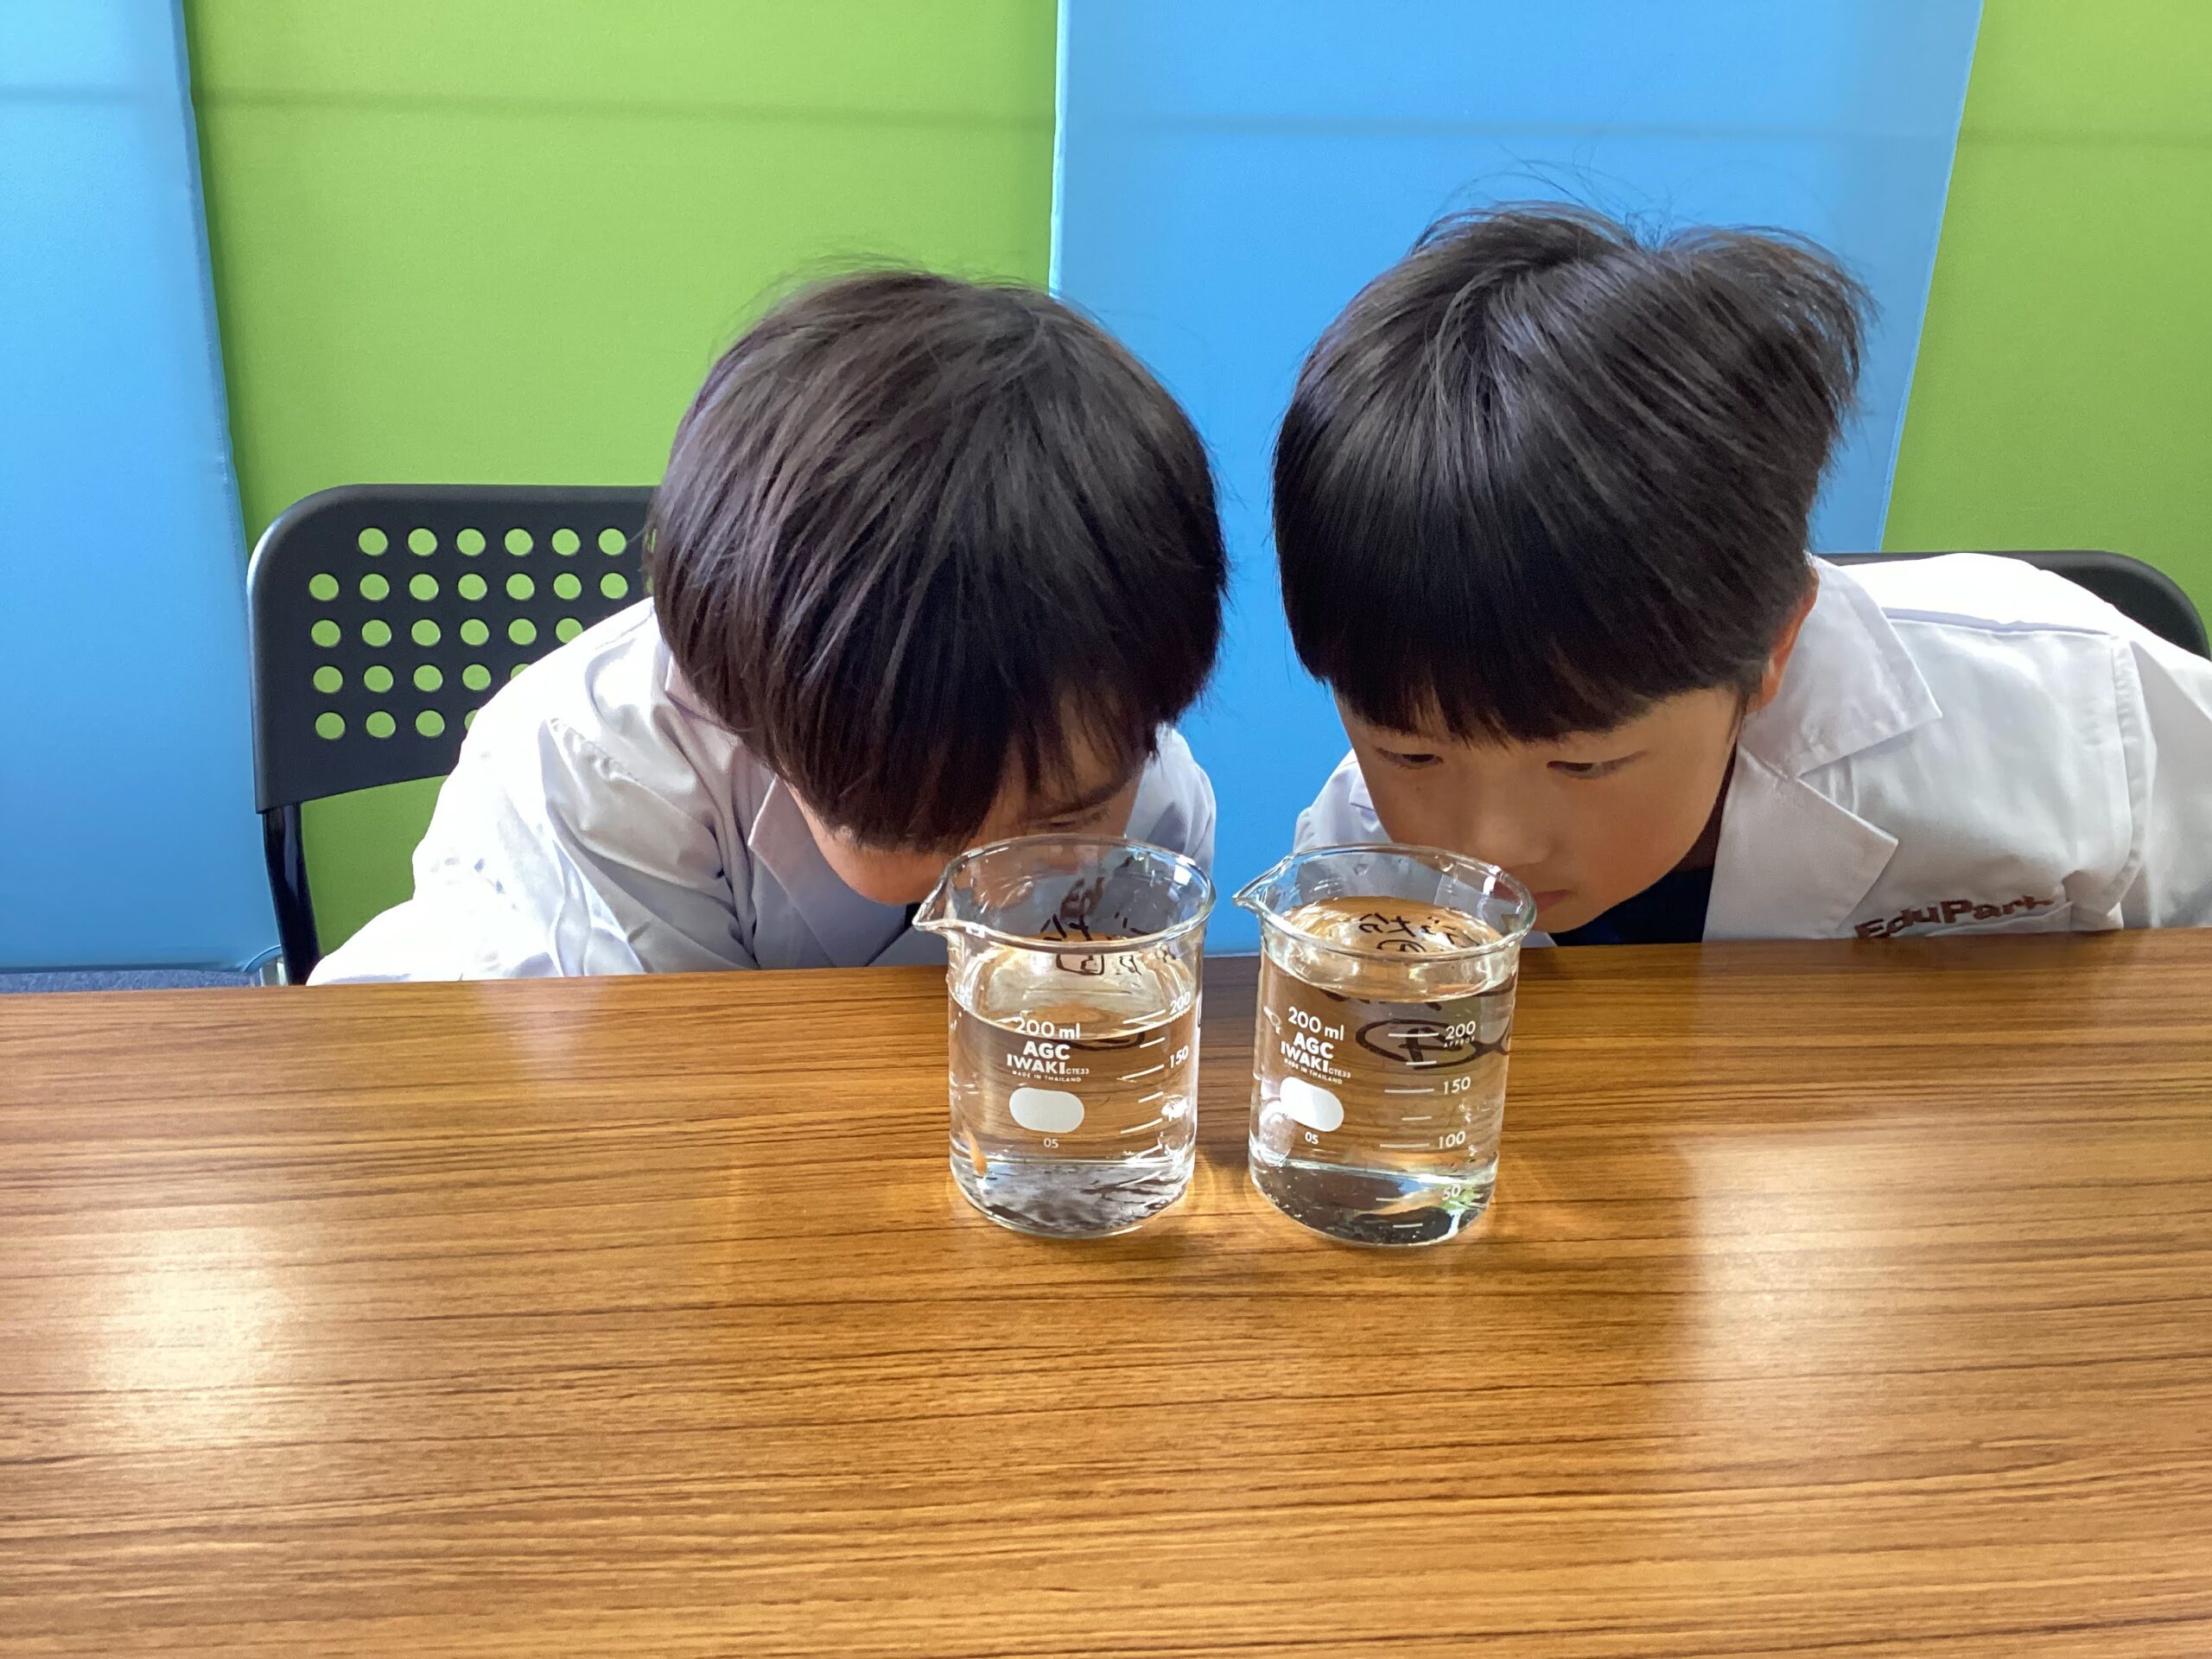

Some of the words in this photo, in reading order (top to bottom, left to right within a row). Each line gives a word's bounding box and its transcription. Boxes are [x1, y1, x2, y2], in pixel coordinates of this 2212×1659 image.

[1014, 1018, 1055, 1038] 200
[1059, 1022, 1080, 1039] ml
[1287, 1006, 1322, 1033] 200
[1324, 1024, 1344, 1041] ml
[1445, 1020, 1476, 1040] 200
[1023, 1040, 1071, 1060] AGC
[1293, 1032, 1334, 1058] AGC
[1007, 1053, 1065, 1074] IWAKI
[1169, 1045, 1189, 1069] 150
[1281, 1040, 1329, 1073] IWAKI
[1309, 1070, 1343, 1084] THAILAND
[1442, 1076, 1471, 1096] 150
[1044, 1138, 1059, 1148] 05
[1305, 1131, 1319, 1145] 05
[1438, 1130, 1466, 1149] 100
[1441, 1184, 1461, 1200] 50
